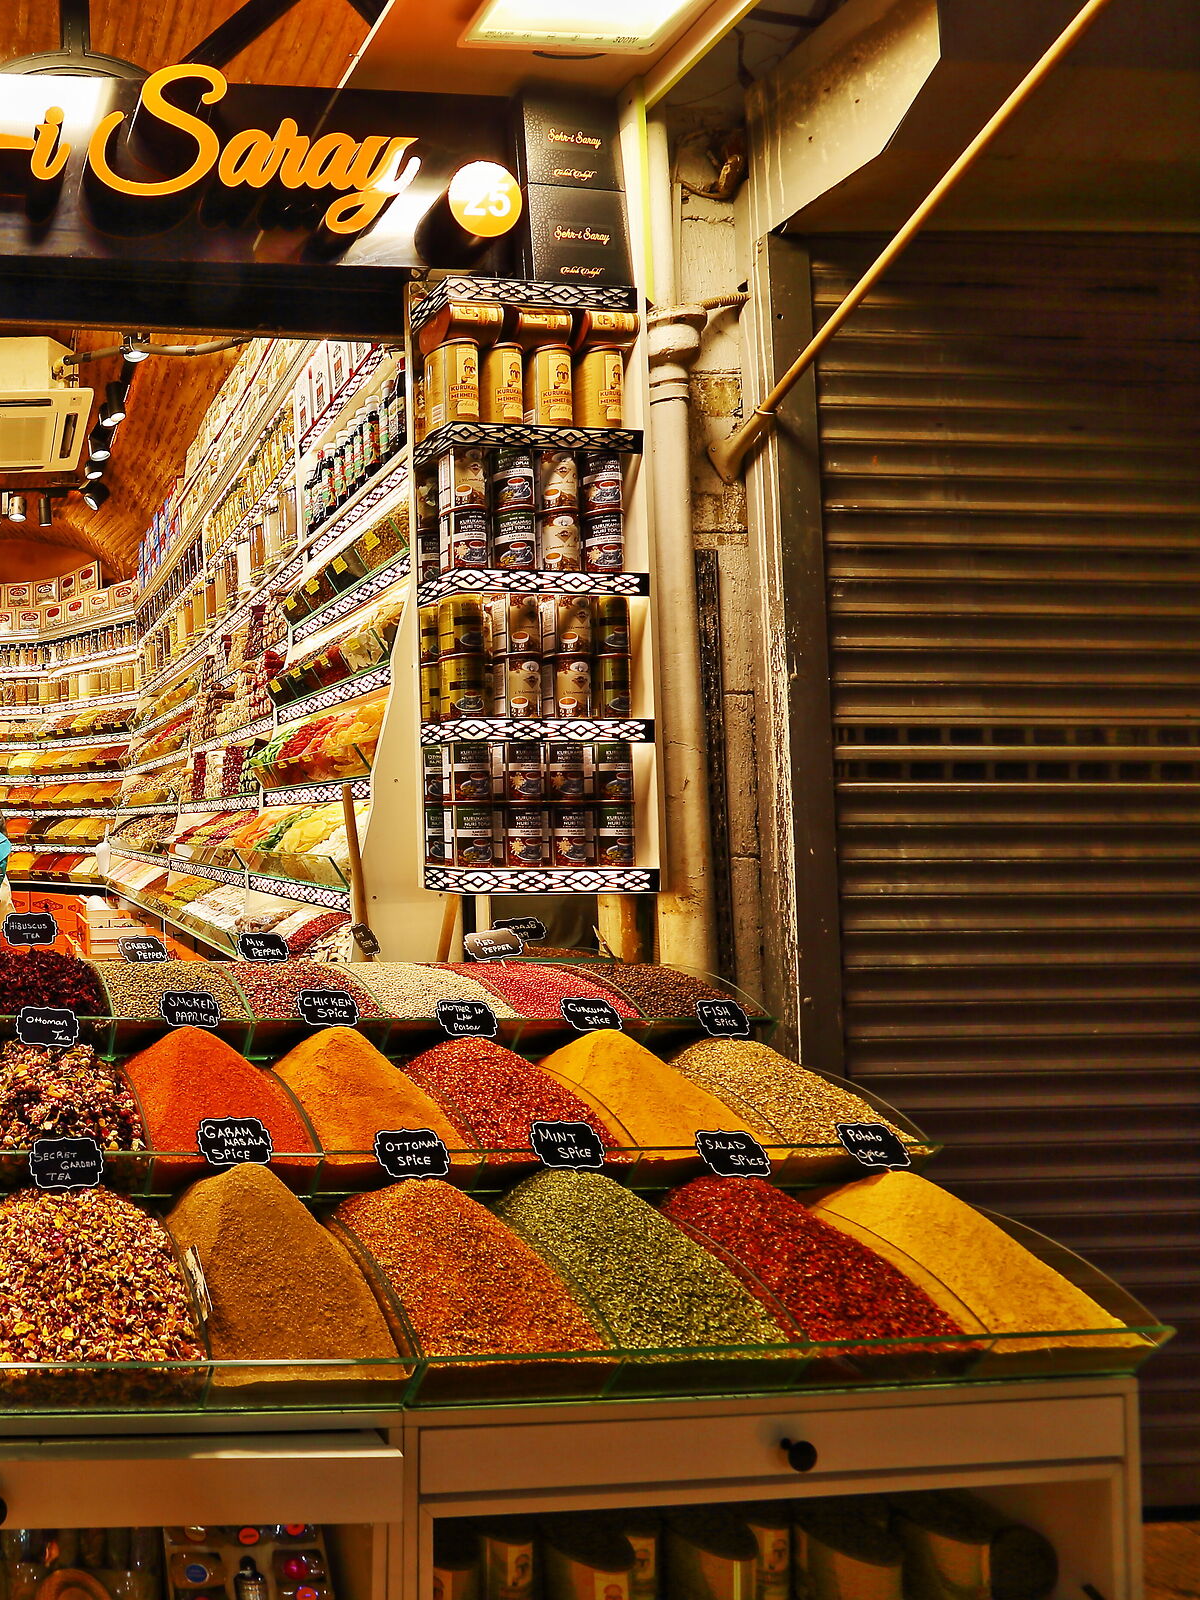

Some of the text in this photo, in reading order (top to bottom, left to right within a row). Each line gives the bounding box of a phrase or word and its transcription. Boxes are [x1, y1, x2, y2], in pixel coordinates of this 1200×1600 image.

[88, 64, 421, 234] Saray
[463, 182, 512, 217] 25
[124, 941, 154, 951] GREEN
[246, 937, 265, 947] MIX
[473, 937, 495, 947] RED
[137, 950, 165, 960] PEPPER
[251, 947, 283, 957] PEPPER
[481, 943, 514, 955] PEPPER
[168, 997, 216, 1010] SMOKED
[303, 997, 352, 1009] CHICKEN
[441, 1004, 472, 1013] MOTHER
[702, 1005, 731, 1018] FISH
[51, 1030, 72, 1041] Tea
[203, 1124, 255, 1140] GARAM
[537, 1127, 577, 1144] MINT
[223, 1135, 268, 1147] MASALA
[384, 1140, 441, 1152] OTTOMAN
[704, 1138, 747, 1151] SALAD
[33, 1151, 78, 1163] SECRET
[60, 1160, 97, 1171] GARDEN
[46, 1171, 72, 1181] TEA
